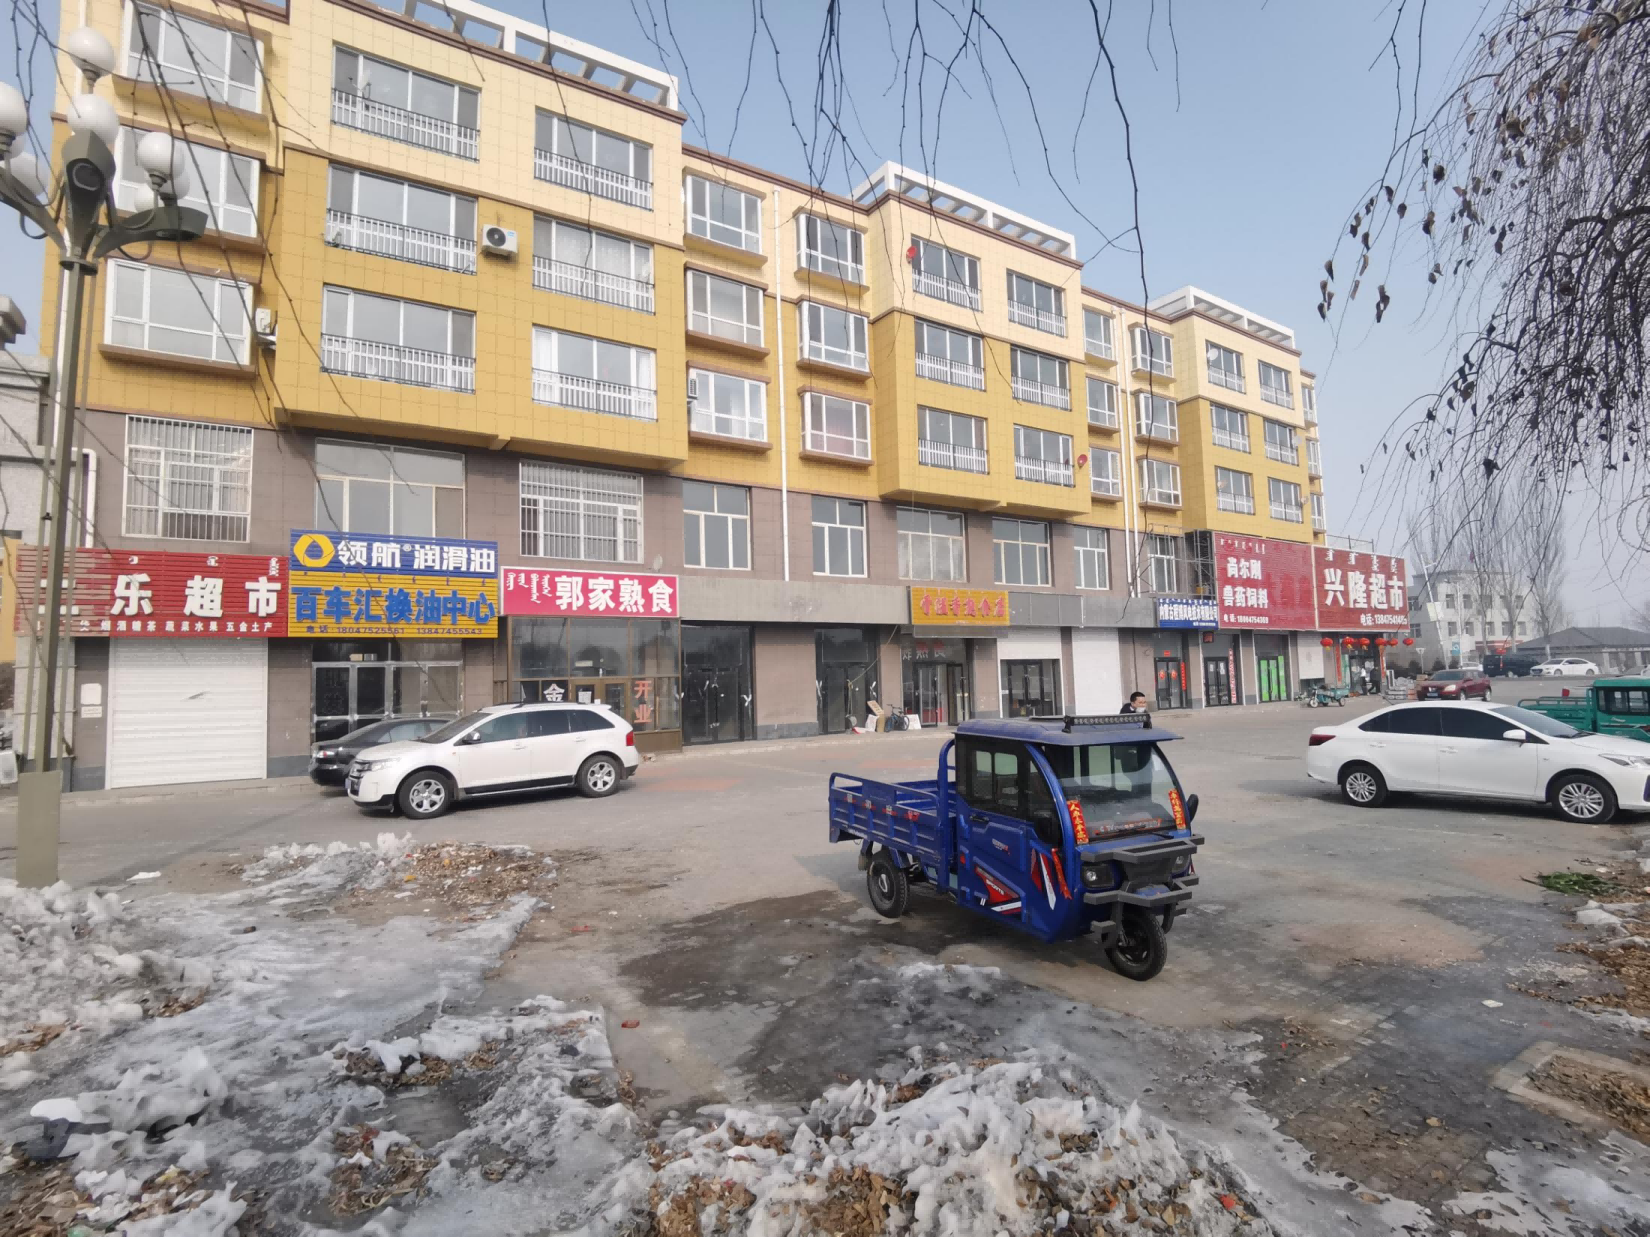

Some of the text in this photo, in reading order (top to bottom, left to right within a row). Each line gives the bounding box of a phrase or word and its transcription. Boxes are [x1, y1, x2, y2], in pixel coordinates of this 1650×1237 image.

[290, 585, 496, 625] 百车汇换油中心
[554, 576, 674, 613] 郭家熟食
[1222, 585, 1269, 608] 兽药饲料
[1323, 568, 1404, 611] 兴隆超市
[226, 621, 273, 632] 五金土产
[633, 680, 653, 723] 开业
